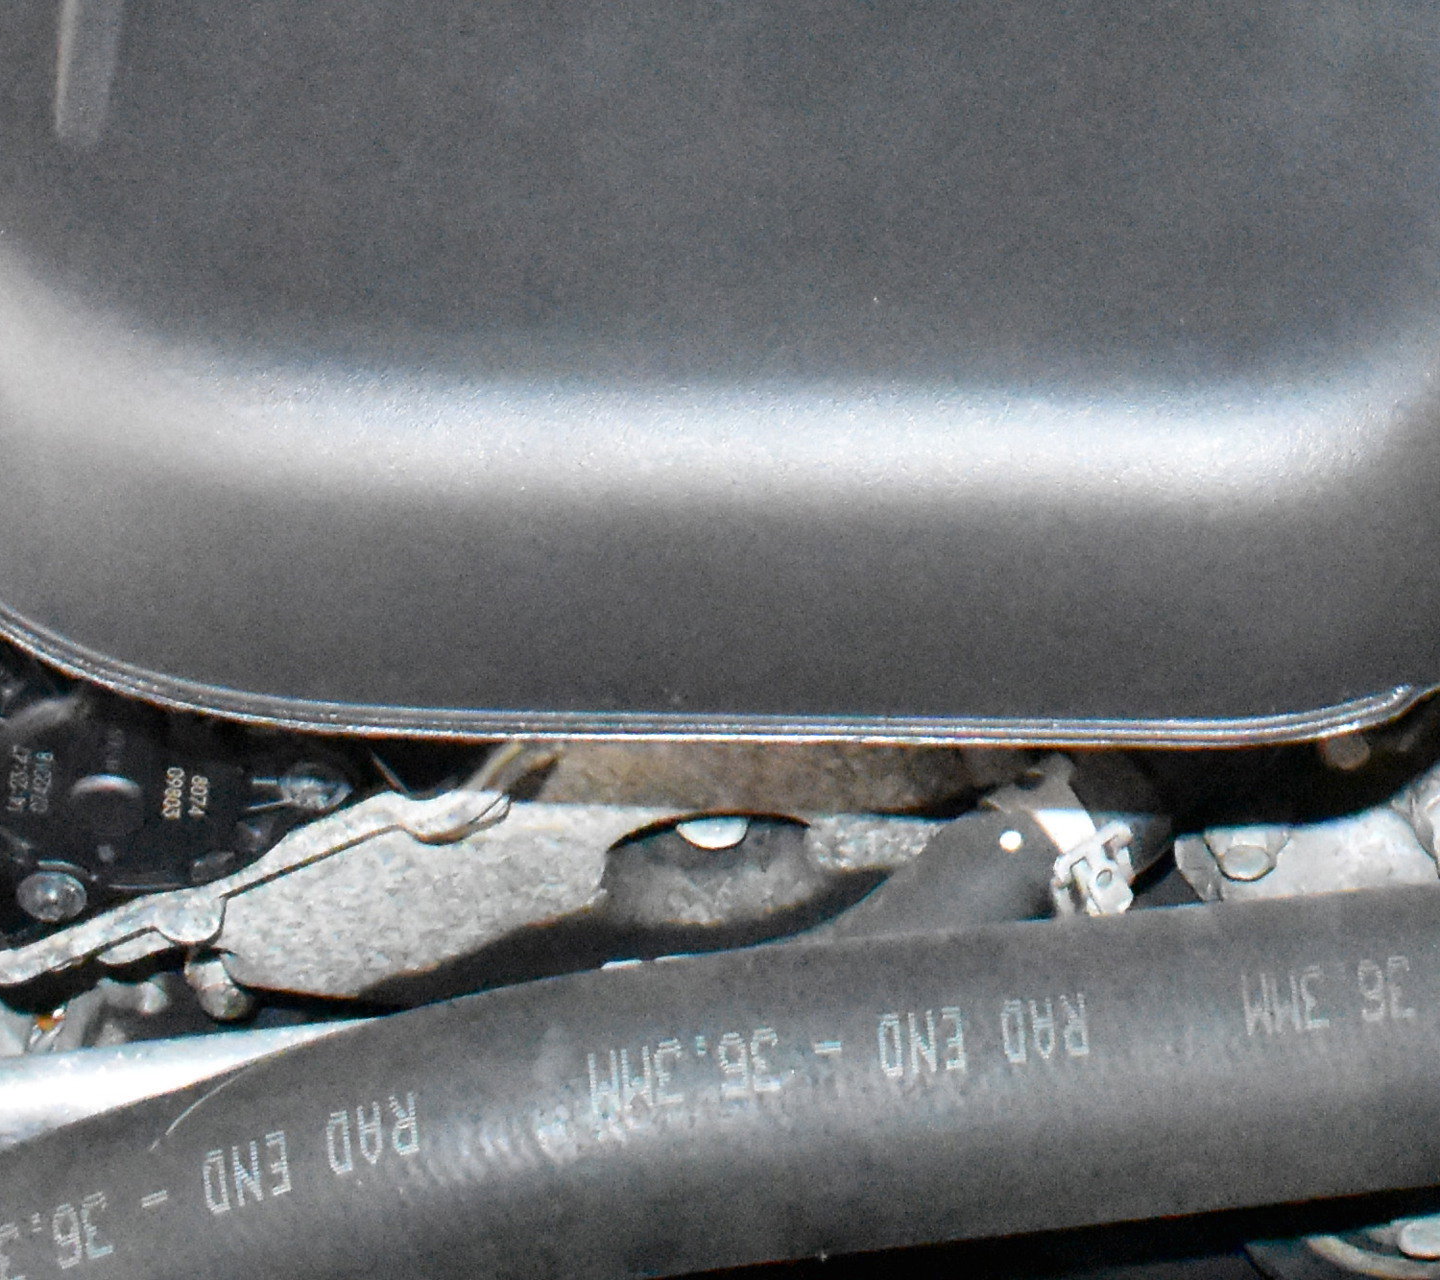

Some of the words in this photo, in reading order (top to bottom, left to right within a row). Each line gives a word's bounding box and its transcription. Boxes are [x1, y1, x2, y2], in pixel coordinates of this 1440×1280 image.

[876, 1006, 966, 1078] END
[1000, 993, 1091, 1064] RAD
[202, 1128, 293, 1216] END
[326, 1091, 421, 1177] RAD
